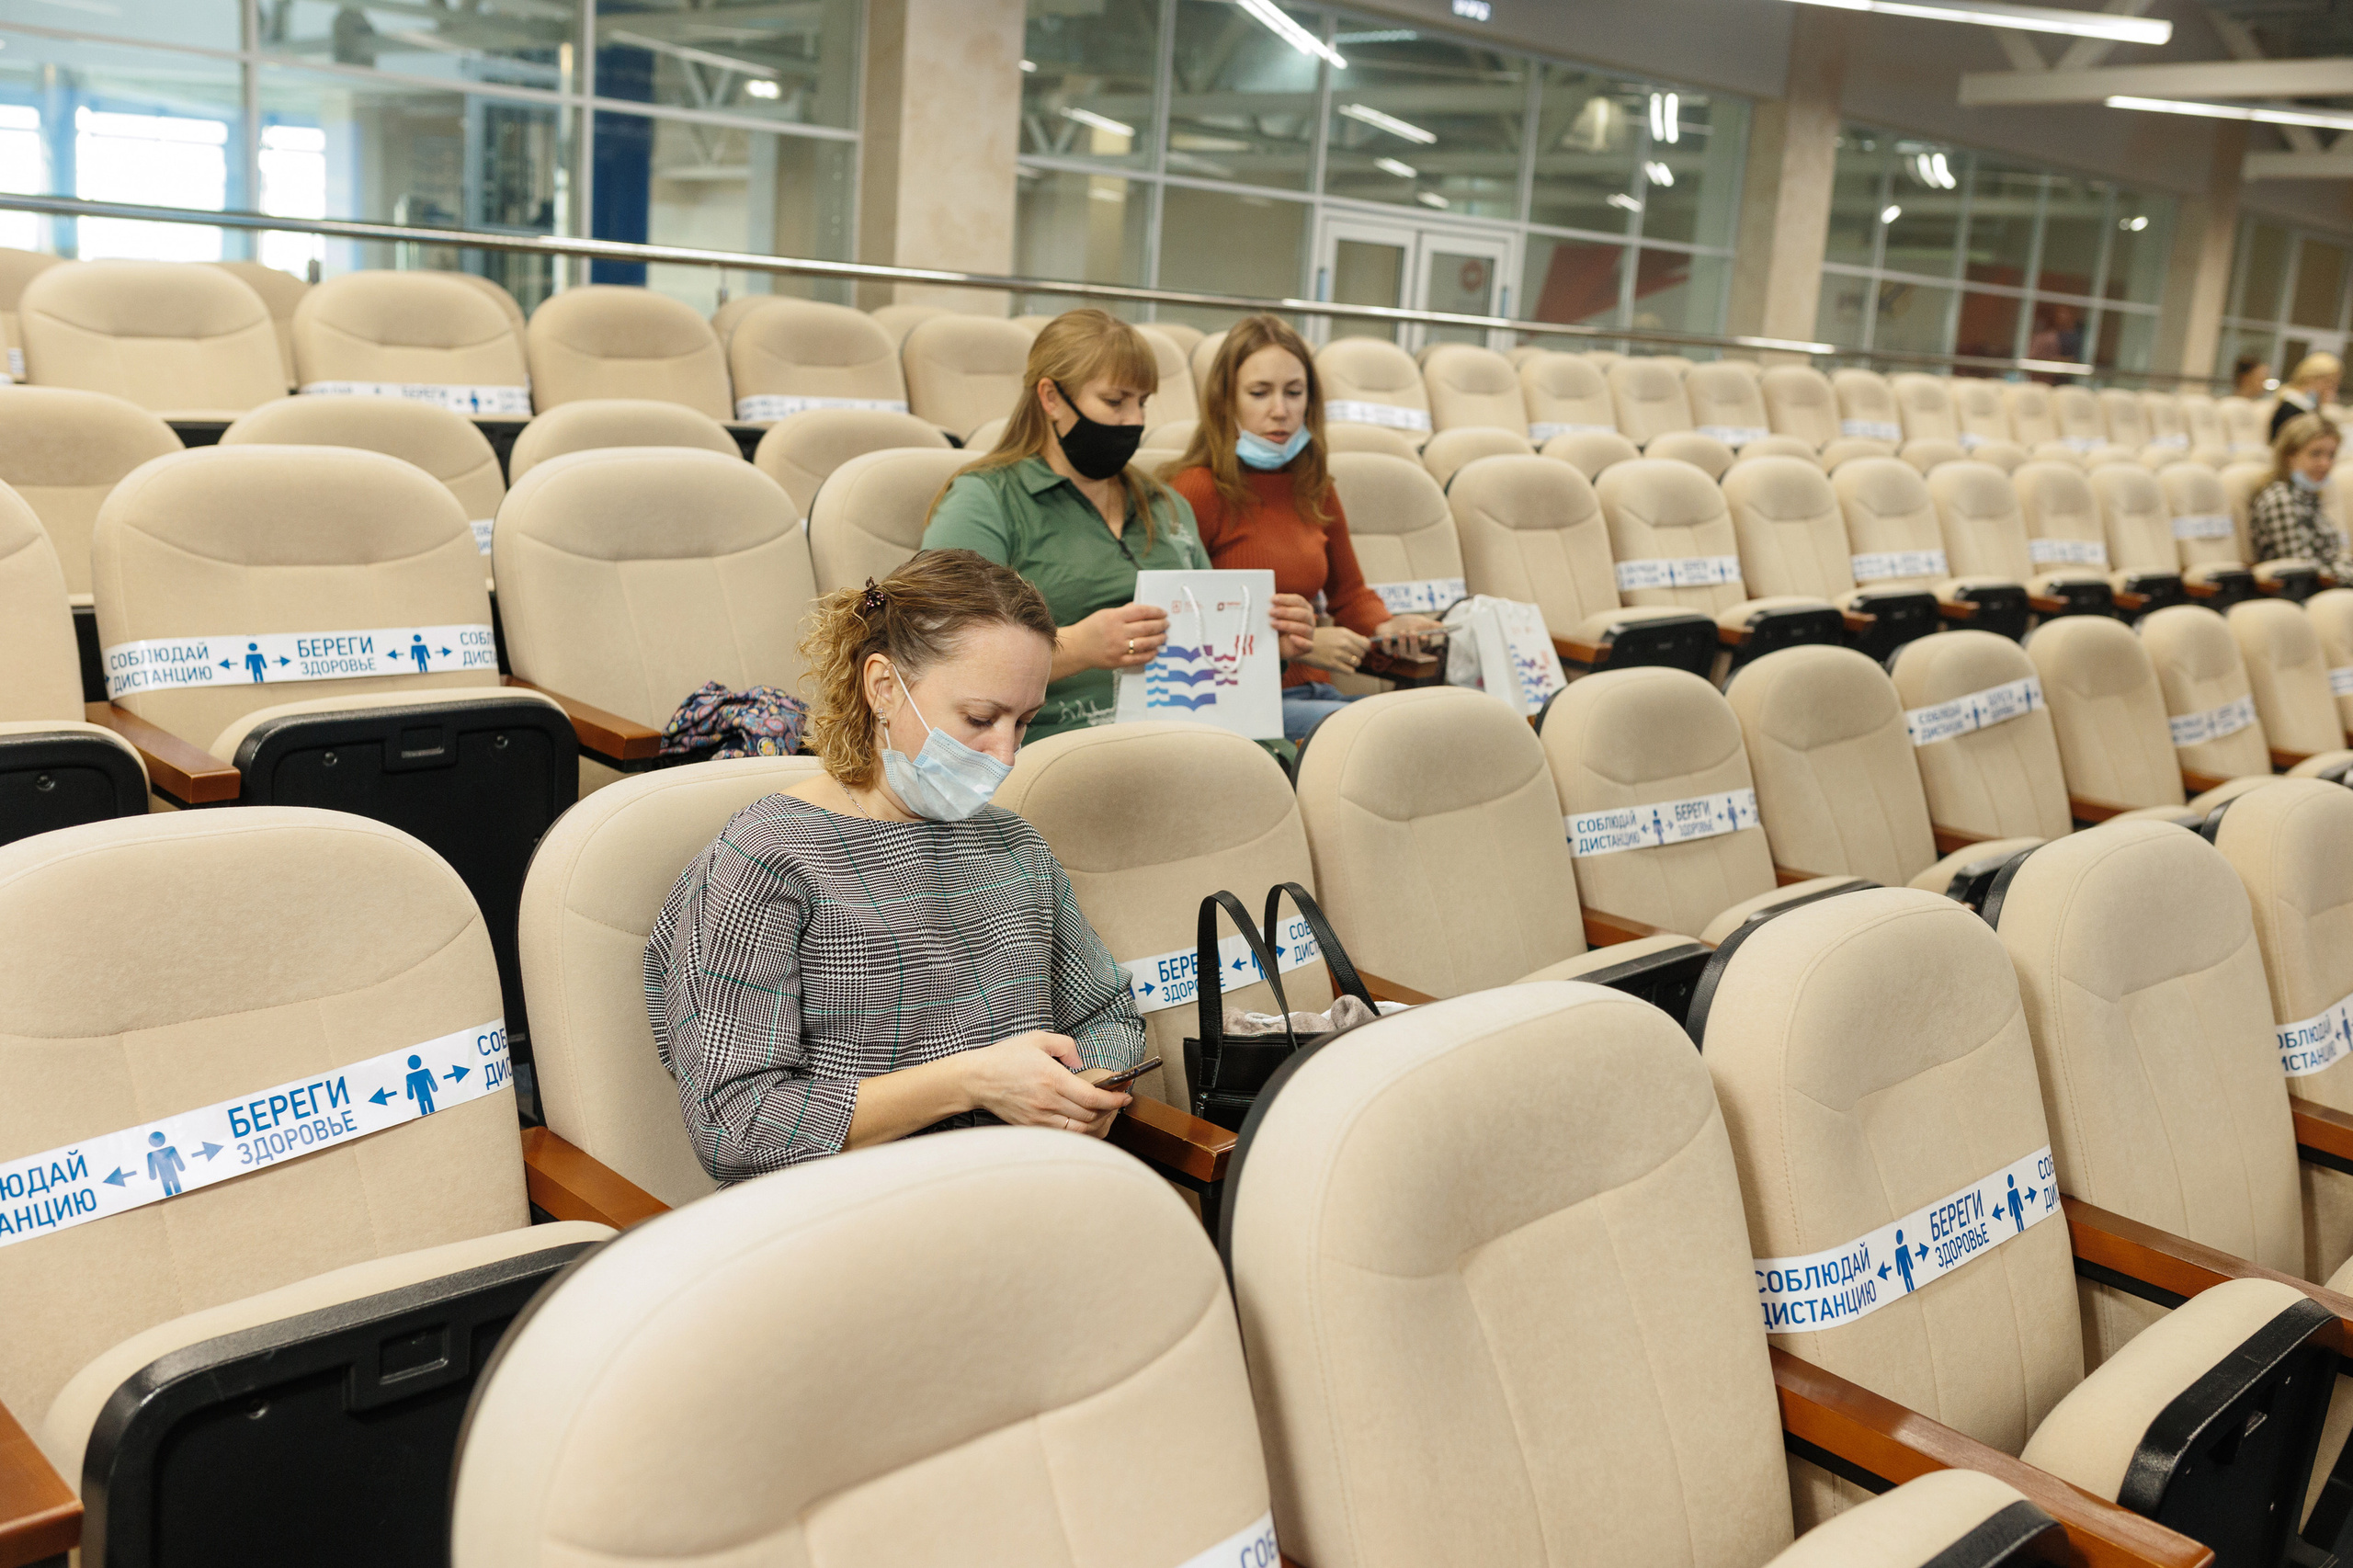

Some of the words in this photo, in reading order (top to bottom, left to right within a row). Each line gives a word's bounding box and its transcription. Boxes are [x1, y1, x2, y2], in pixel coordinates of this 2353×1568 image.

[110, 642, 210, 670] СОБЛЮДАЙ
[297, 636, 374, 658] БЕРЕГИ
[114, 665, 212, 693] ДИСТАНЦИЮ
[301, 657, 376, 676] ЗДОРОВЬЕ
[1577, 811, 1637, 834] СОБЛЮДАЙ
[1675, 801, 1711, 822] БЕРЕГИ
[227, 1076, 350, 1139] БЕРЕГИ
[236, 1109, 358, 1165] ЗДОРОВЬЕ
[1930, 1189, 1984, 1242] БЕРЕГИ
[1935, 1222, 1990, 1269] ЗДОРОВЬЕ
